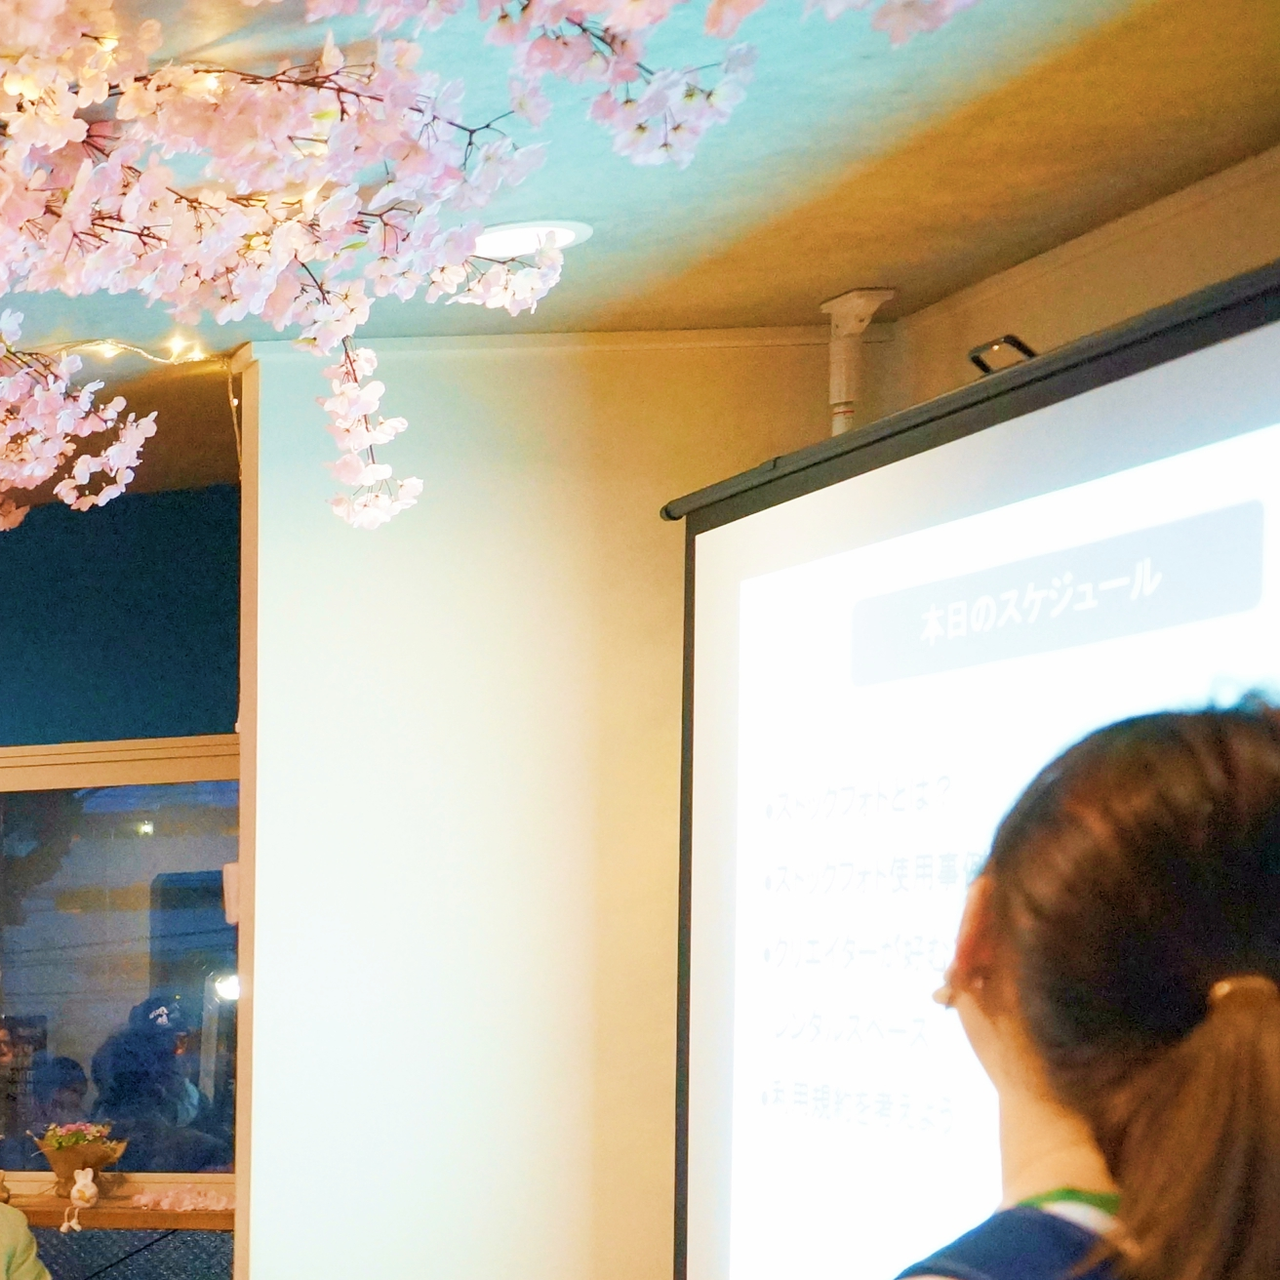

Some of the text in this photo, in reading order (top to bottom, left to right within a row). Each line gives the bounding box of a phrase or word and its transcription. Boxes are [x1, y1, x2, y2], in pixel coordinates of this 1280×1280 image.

[919, 556, 1164, 646] 本日のスケジュール
